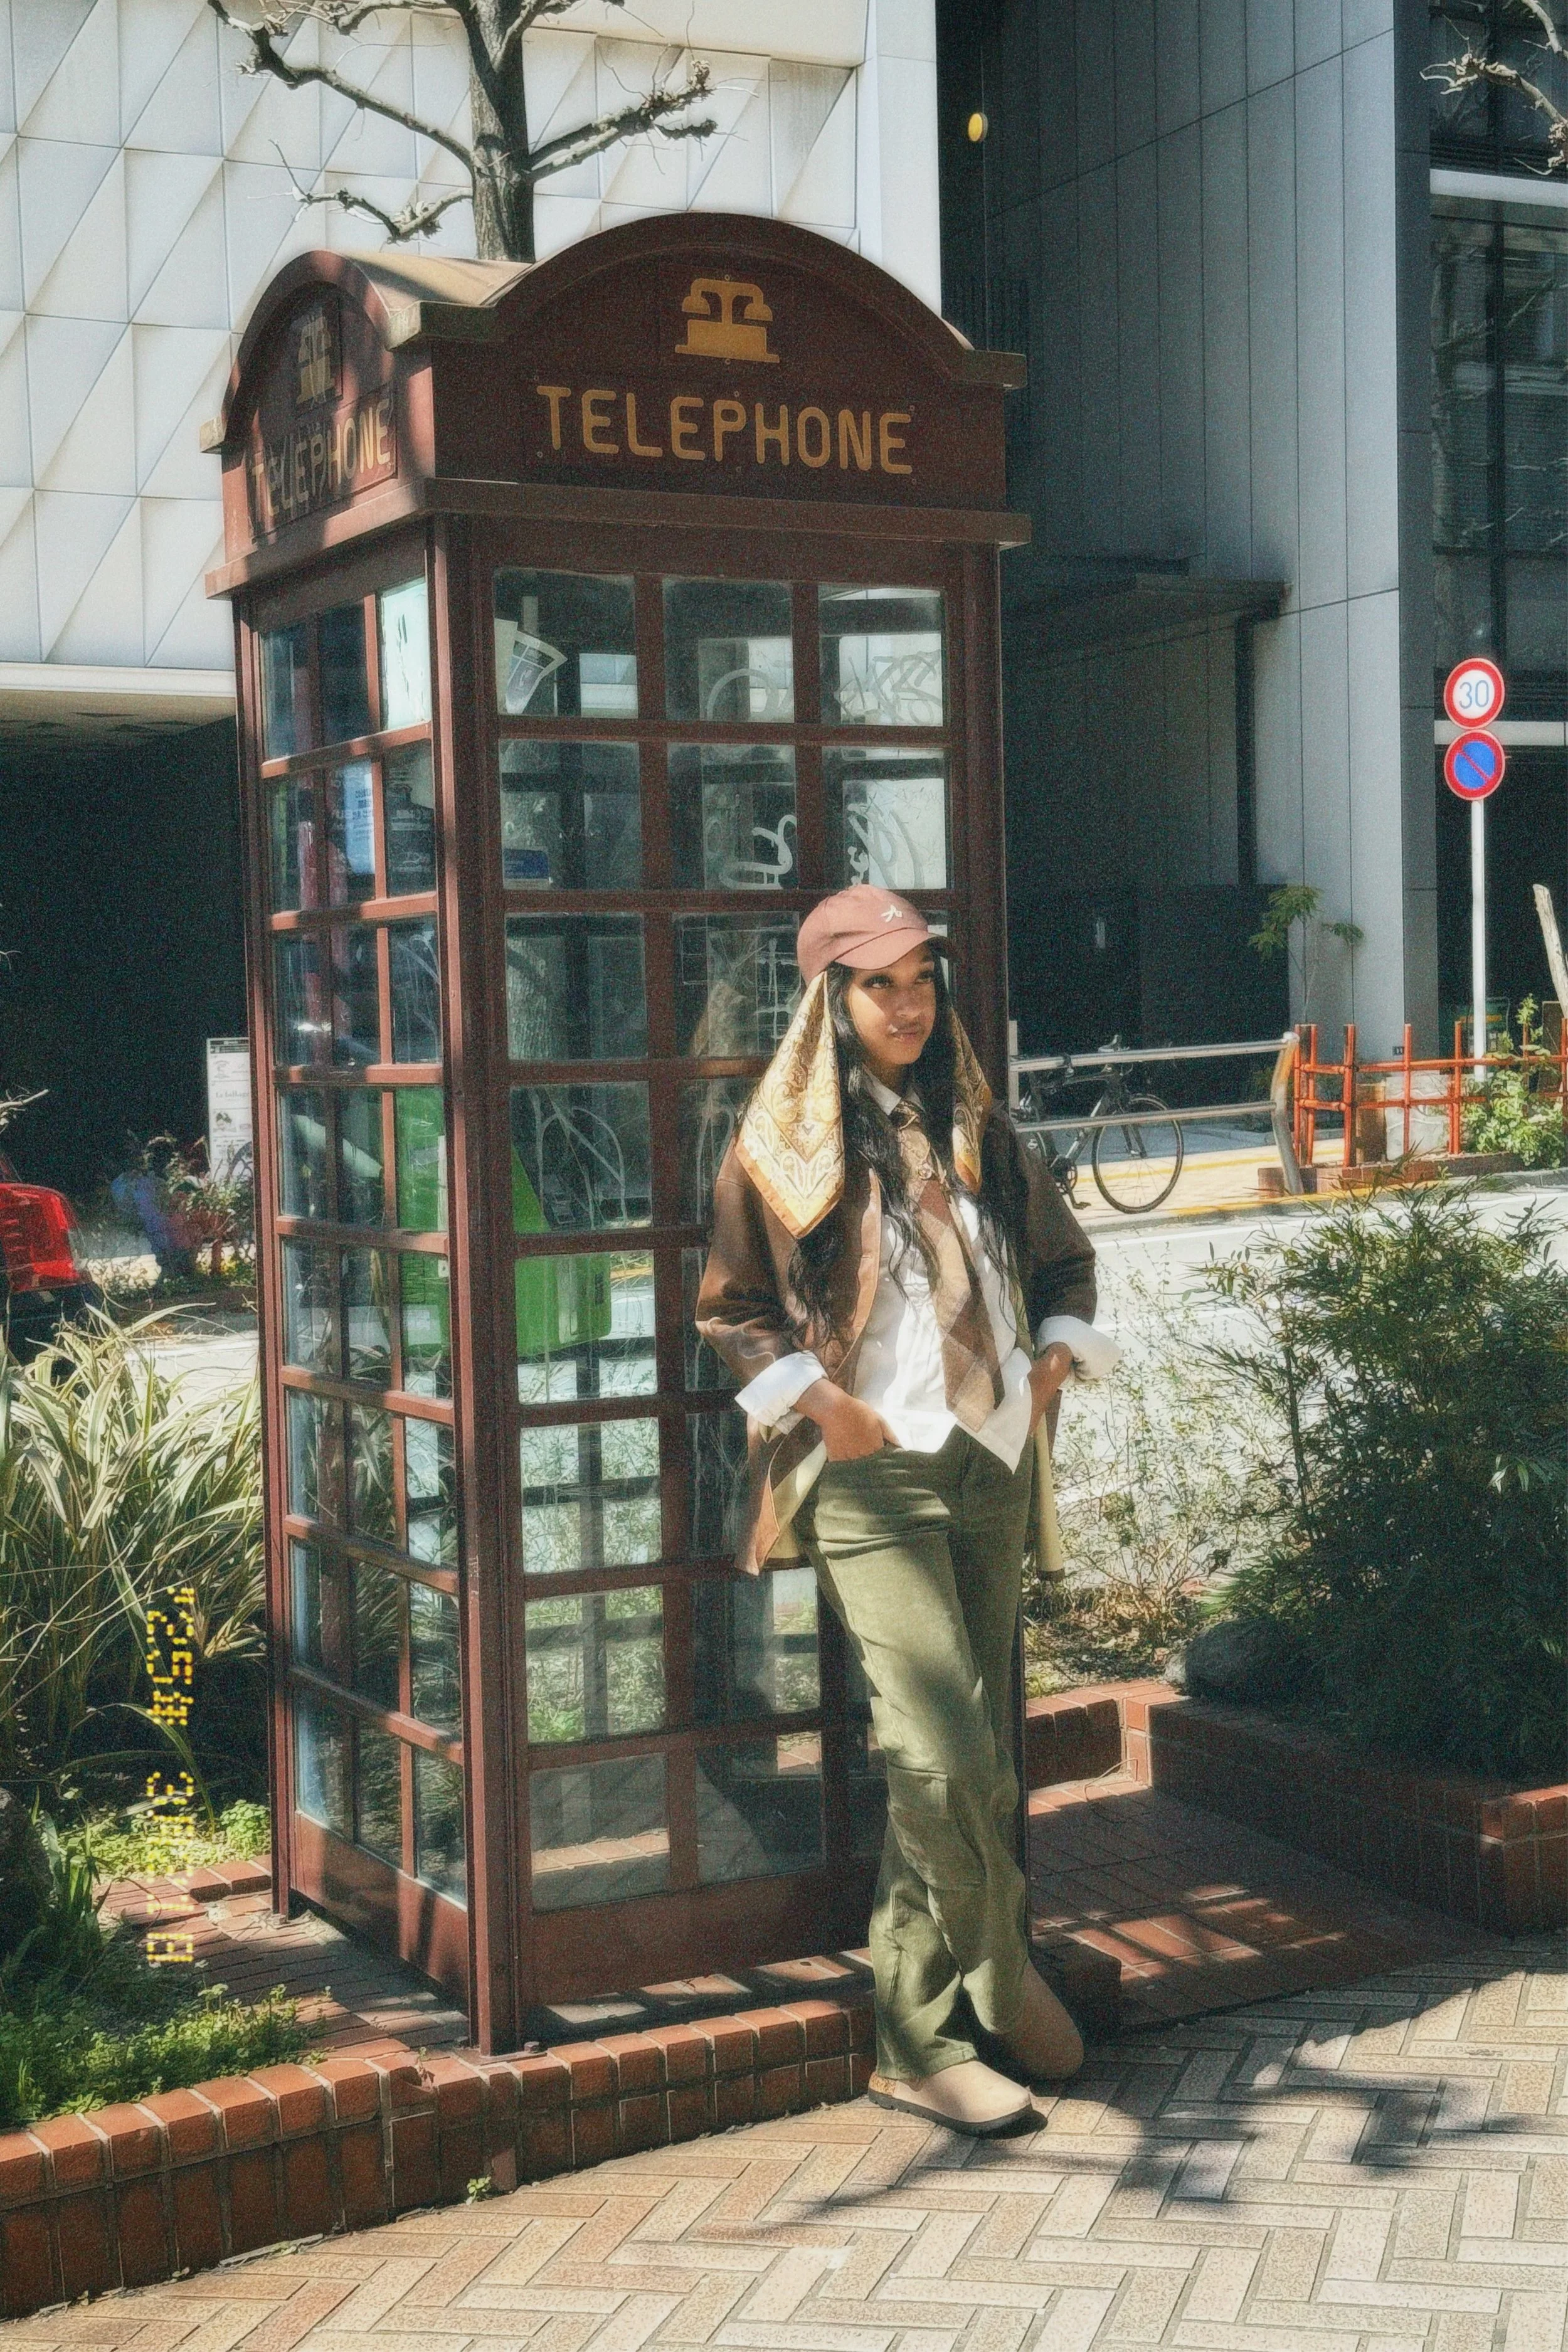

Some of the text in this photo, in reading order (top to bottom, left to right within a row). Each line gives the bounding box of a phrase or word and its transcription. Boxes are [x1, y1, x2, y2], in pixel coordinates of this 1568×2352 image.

[252, 398, 390, 521] TELEPHONE
[536, 384, 913, 475] TELEPHONE
[1459, 679, 1490, 710] 30
